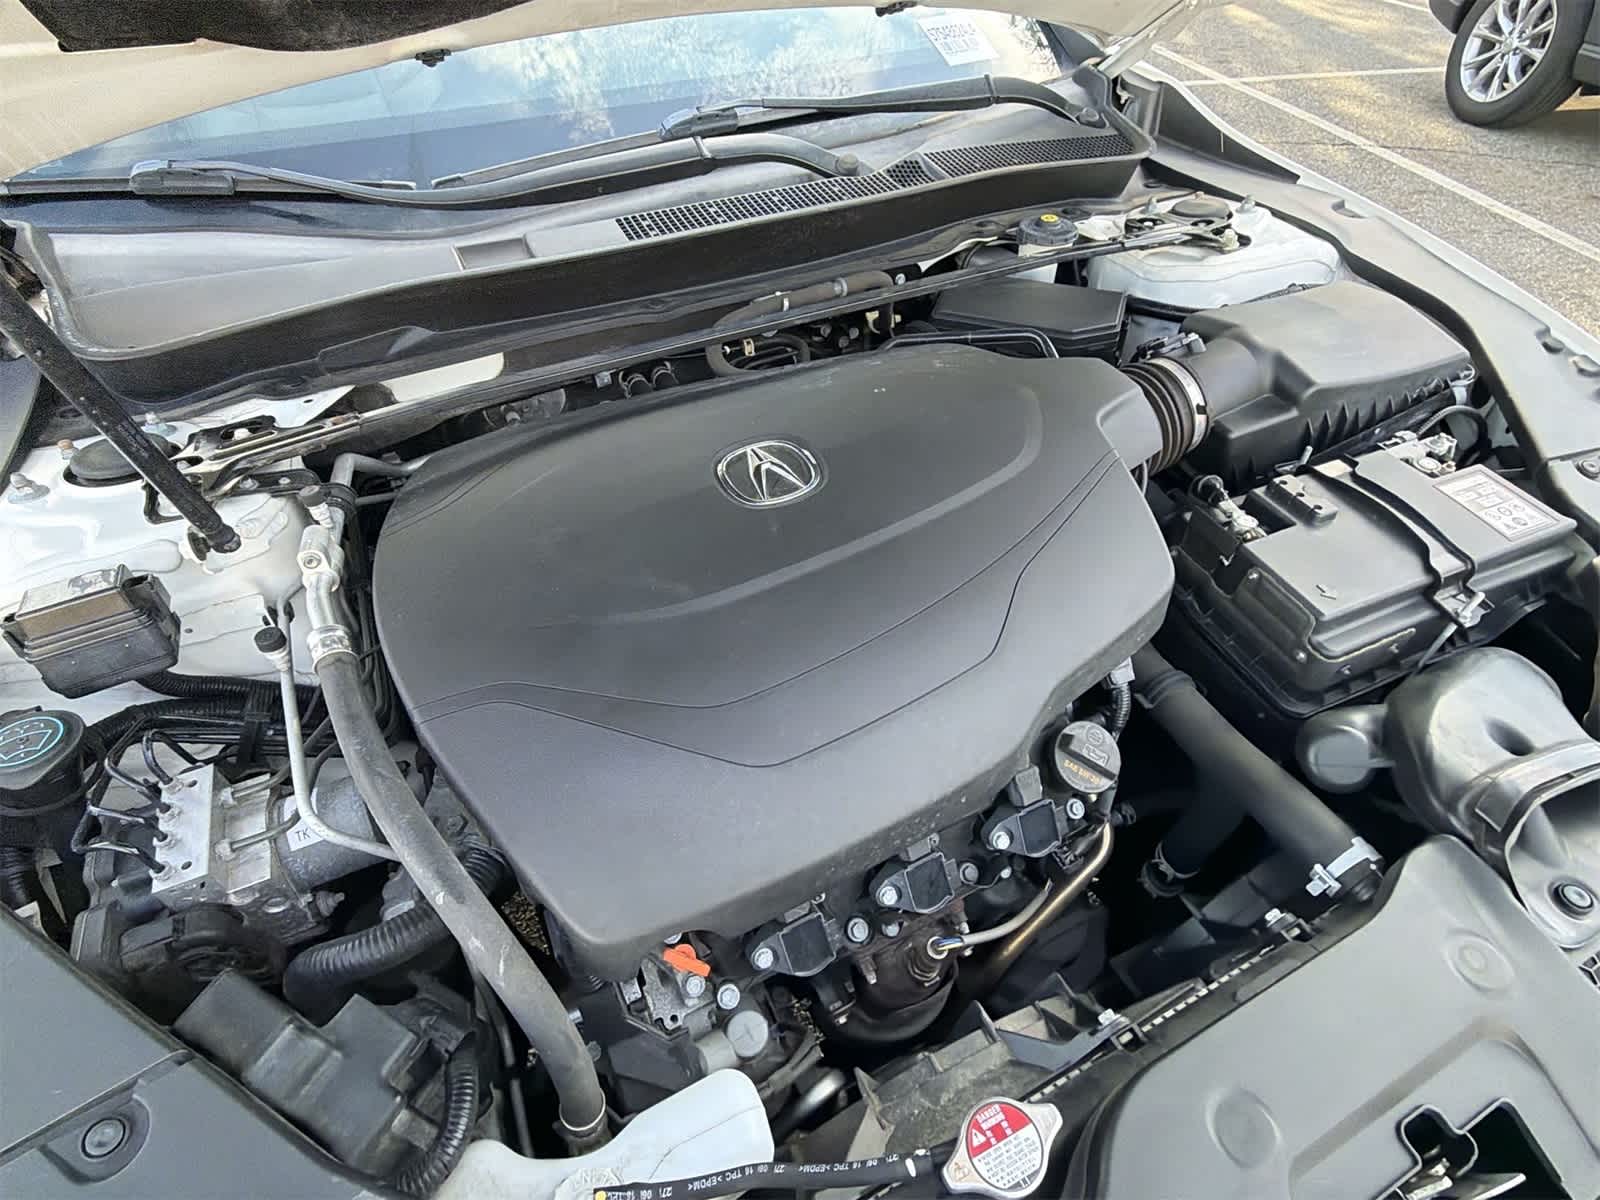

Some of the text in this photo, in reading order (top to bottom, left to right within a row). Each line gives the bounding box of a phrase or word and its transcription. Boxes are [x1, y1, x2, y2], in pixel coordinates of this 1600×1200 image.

[295, 827, 311, 842] TK
[833, 1163, 849, 1171] TPC
[725, 1169, 742, 1181] TPC
